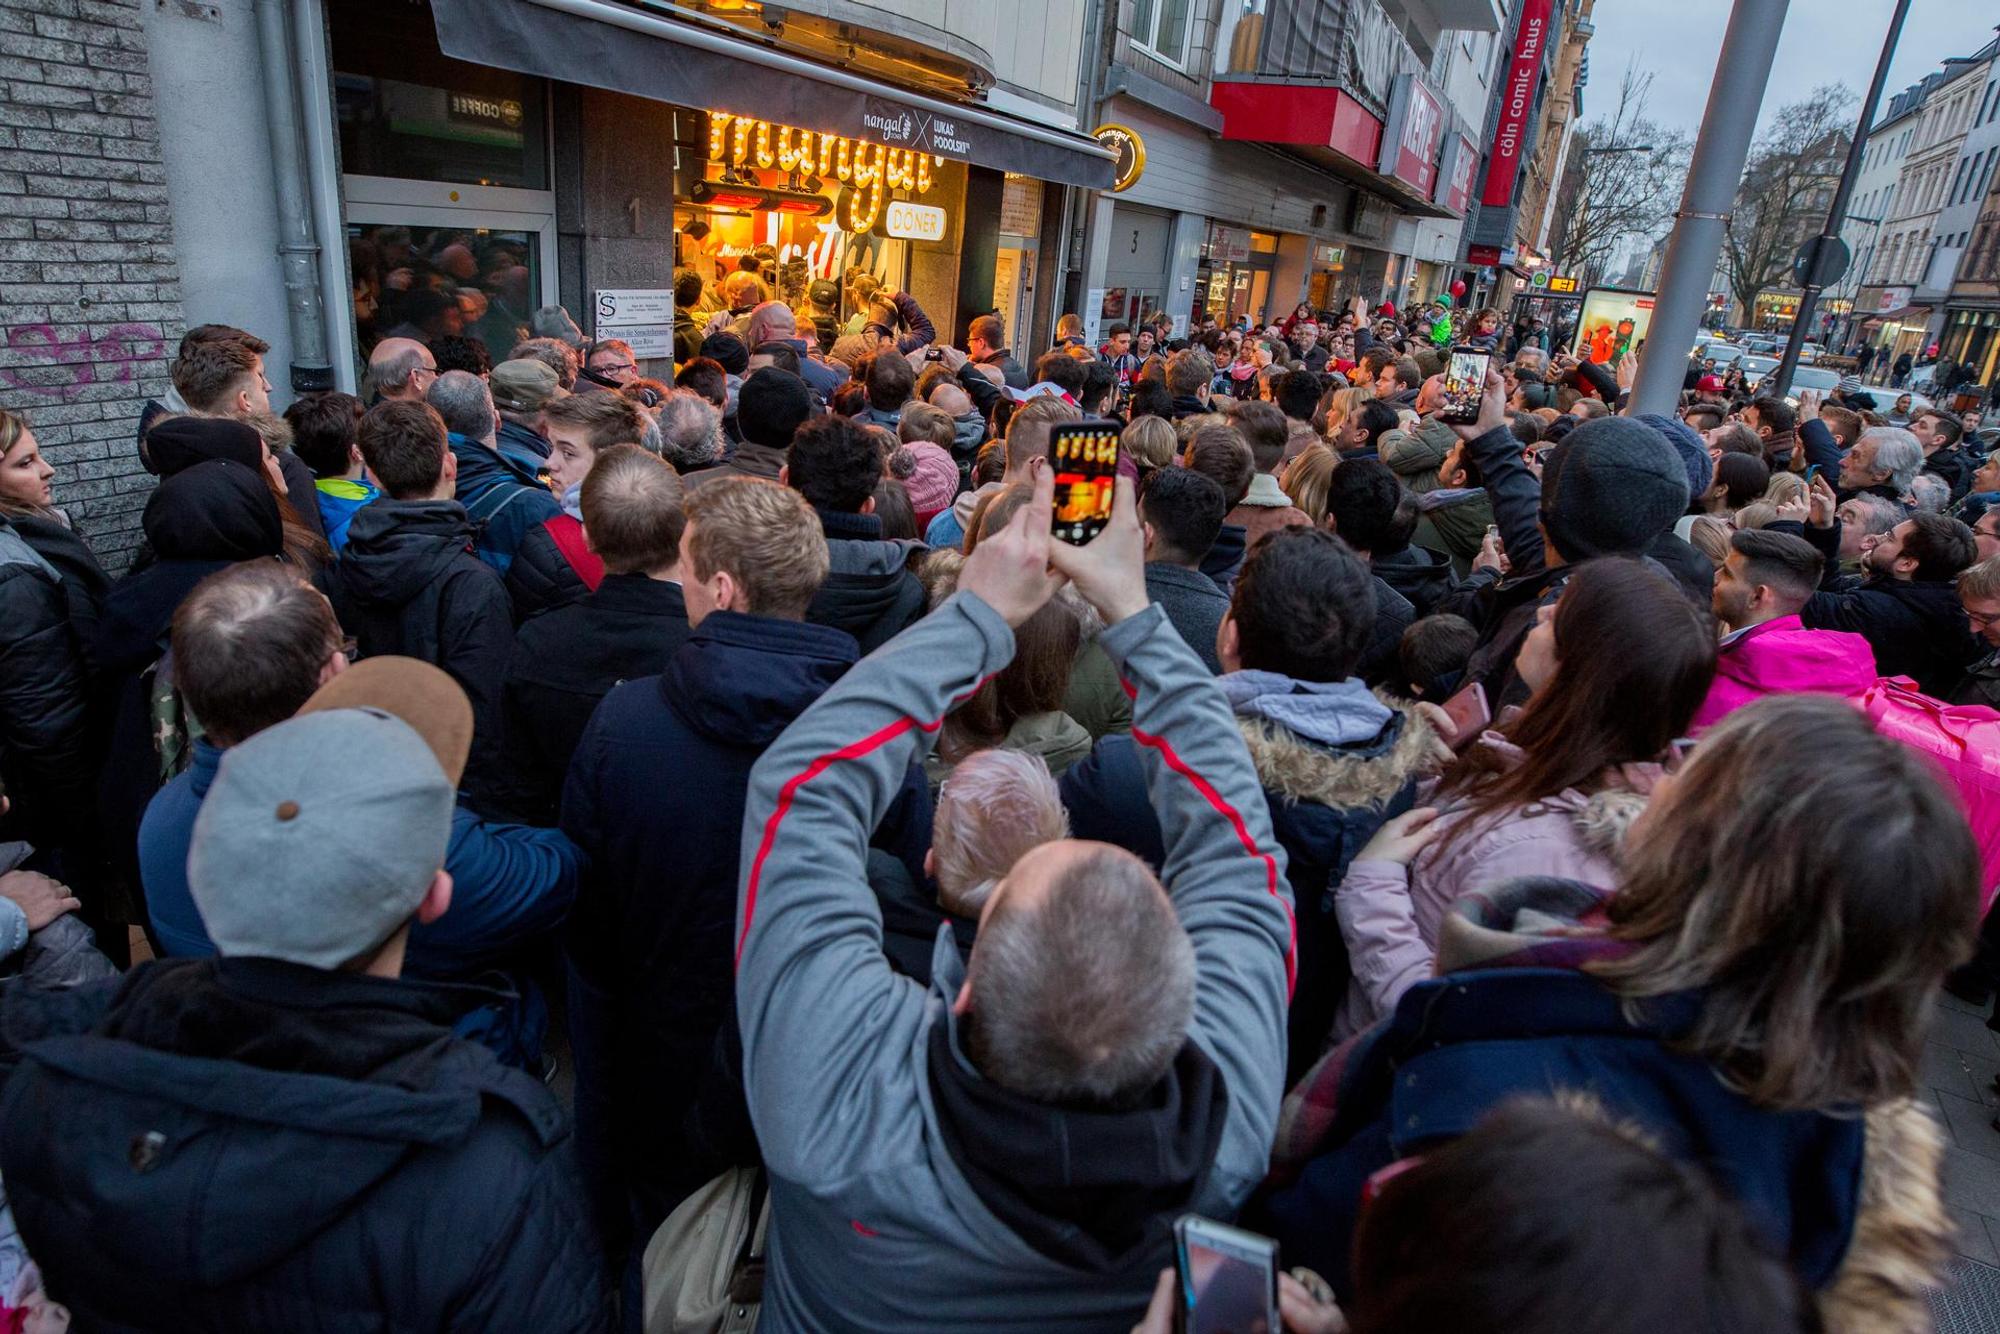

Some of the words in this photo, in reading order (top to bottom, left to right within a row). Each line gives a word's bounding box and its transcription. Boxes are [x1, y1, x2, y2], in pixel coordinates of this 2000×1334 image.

[1519, 18, 1541, 59] haus
[1511, 68, 1531, 118] comic
[933, 119, 954, 137] LUKAS
[1098, 130, 1131, 141] mangal
[1402, 84, 1438, 165] REWE
[1501, 122, 1518, 157] cöln
[1451, 138, 1475, 193] REWE
[629, 198, 640, 234] 1
[892, 206, 938, 234] DÖNER
[1130, 230, 1139, 254] 3
